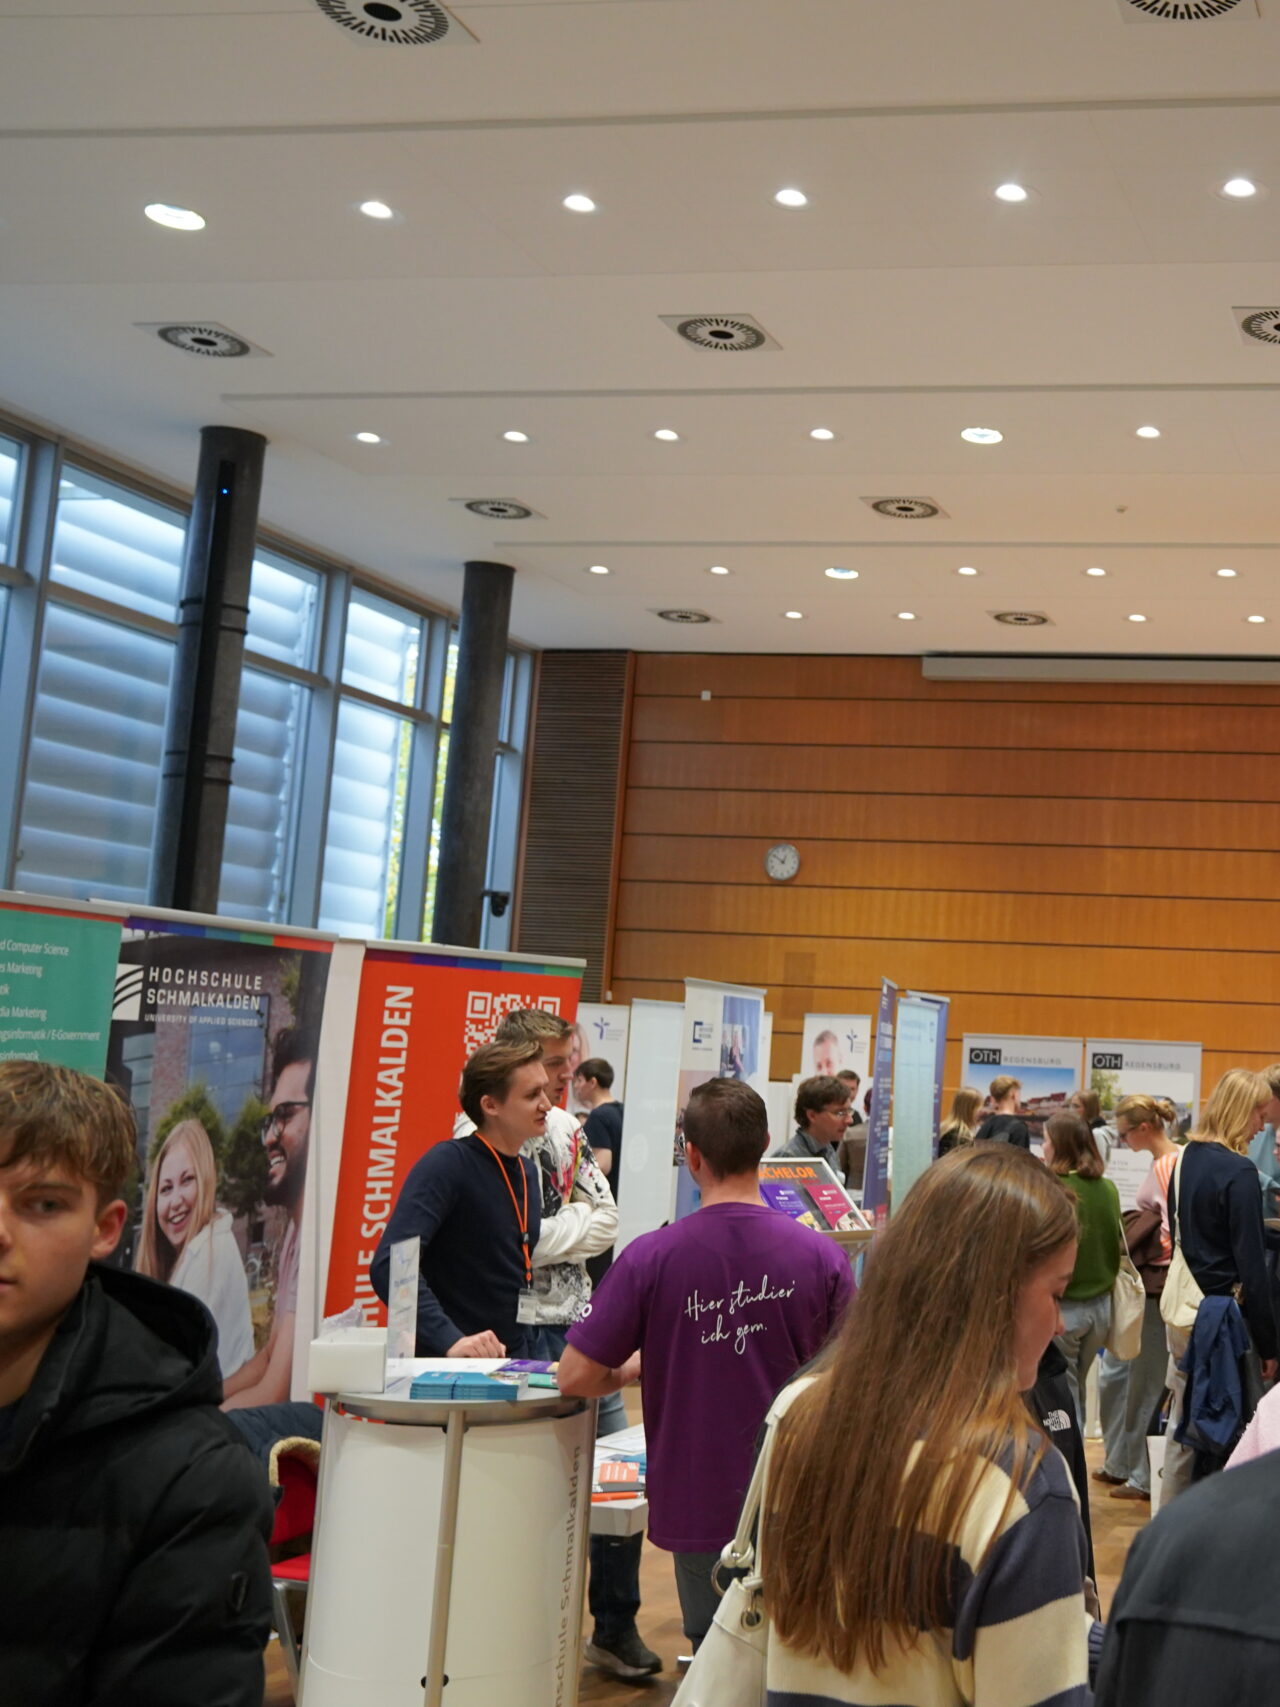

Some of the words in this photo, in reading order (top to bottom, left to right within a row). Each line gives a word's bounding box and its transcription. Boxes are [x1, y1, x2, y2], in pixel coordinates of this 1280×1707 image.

[7, 940, 42, 955] Computer
[43, 943, 70, 956] Science
[7, 962, 43, 978] Marketing
[149, 966, 263, 990] HOCHSCHULE
[146, 988, 261, 1011] SCHMALKALDEN
[11, 1006, 47, 1021] Marketing
[971, 1049, 1000, 1064] OTH
[1093, 1054, 1122, 1069] OTH
[360, 985, 415, 1239] SCHMALKALDEN
[684, 1289, 724, 1321] Hier
[701, 1314, 731, 1344] ich
[561, 1446, 581, 1610] Schmalkalden
